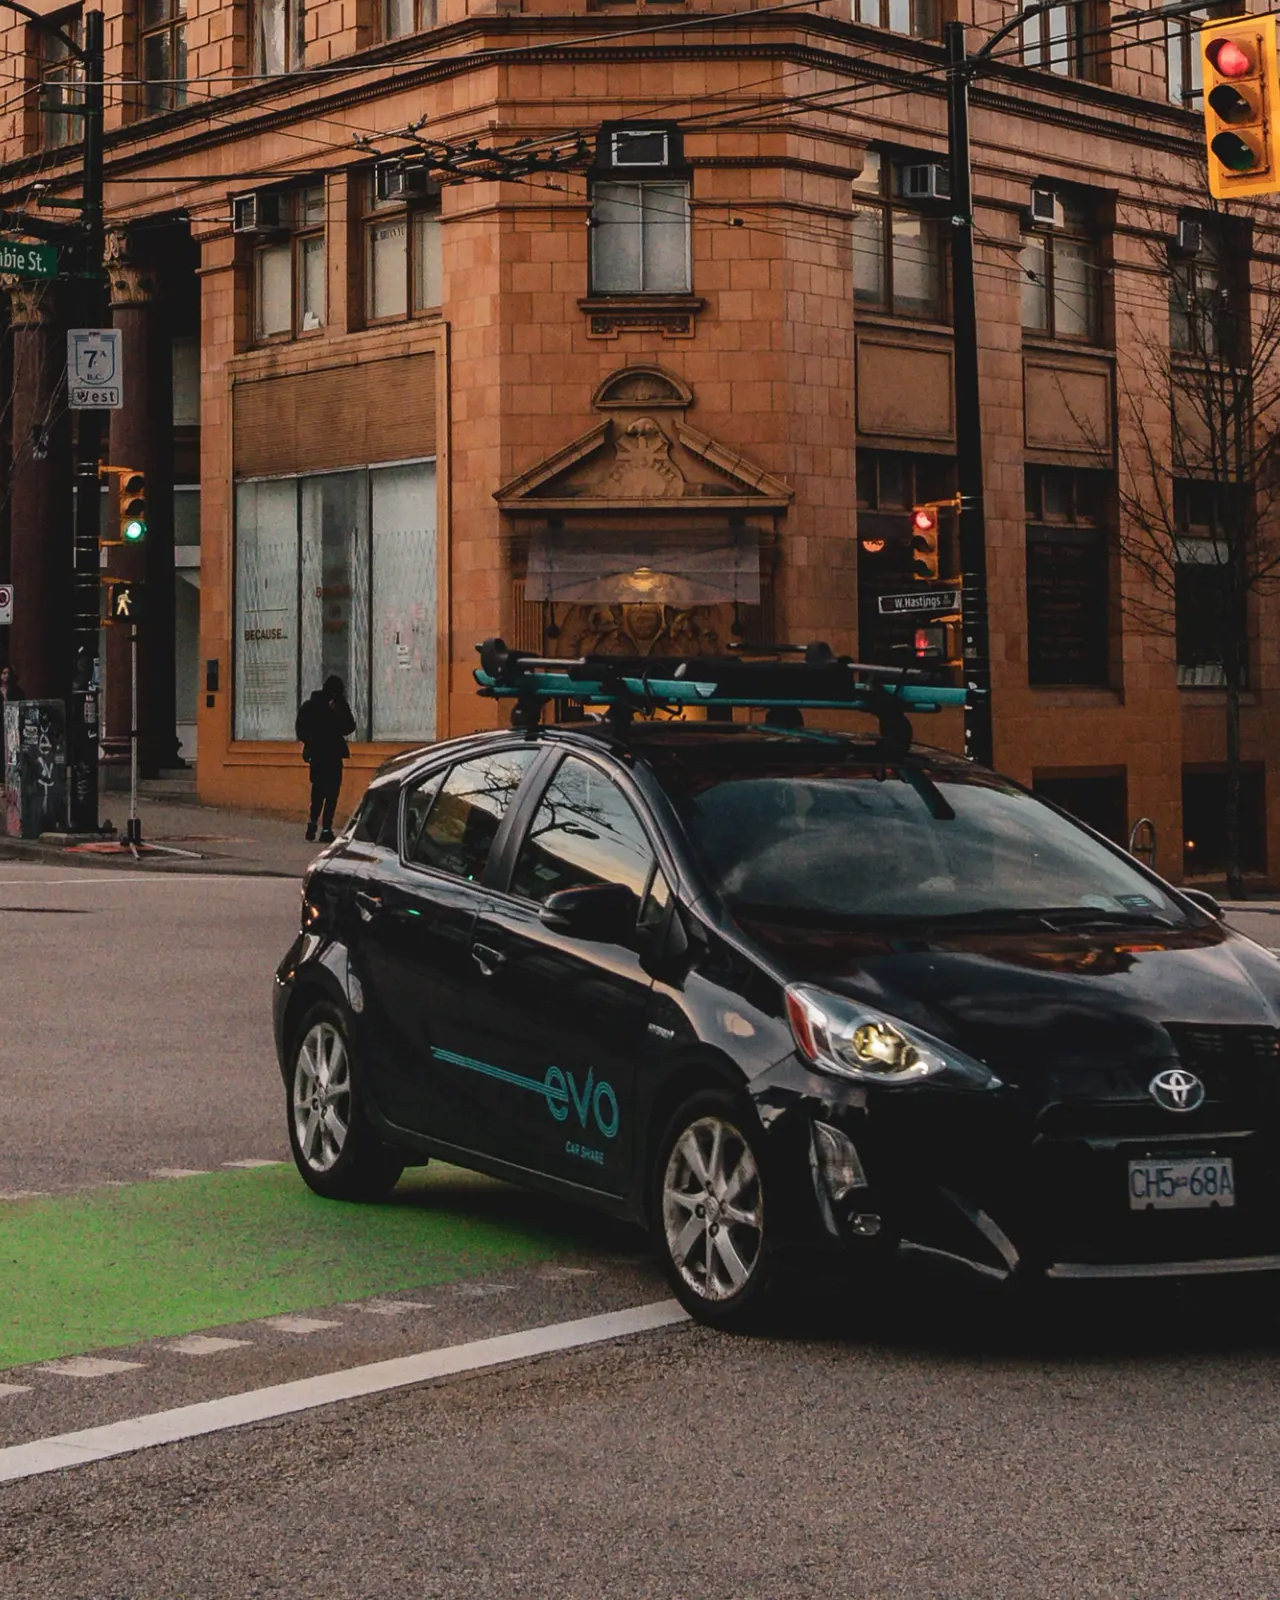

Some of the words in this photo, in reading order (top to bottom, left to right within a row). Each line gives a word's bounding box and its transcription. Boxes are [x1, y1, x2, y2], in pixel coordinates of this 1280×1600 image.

[27, 251, 48, 273] St.
[76, 391, 115, 403] West
[545, 1065, 619, 1138] evo
